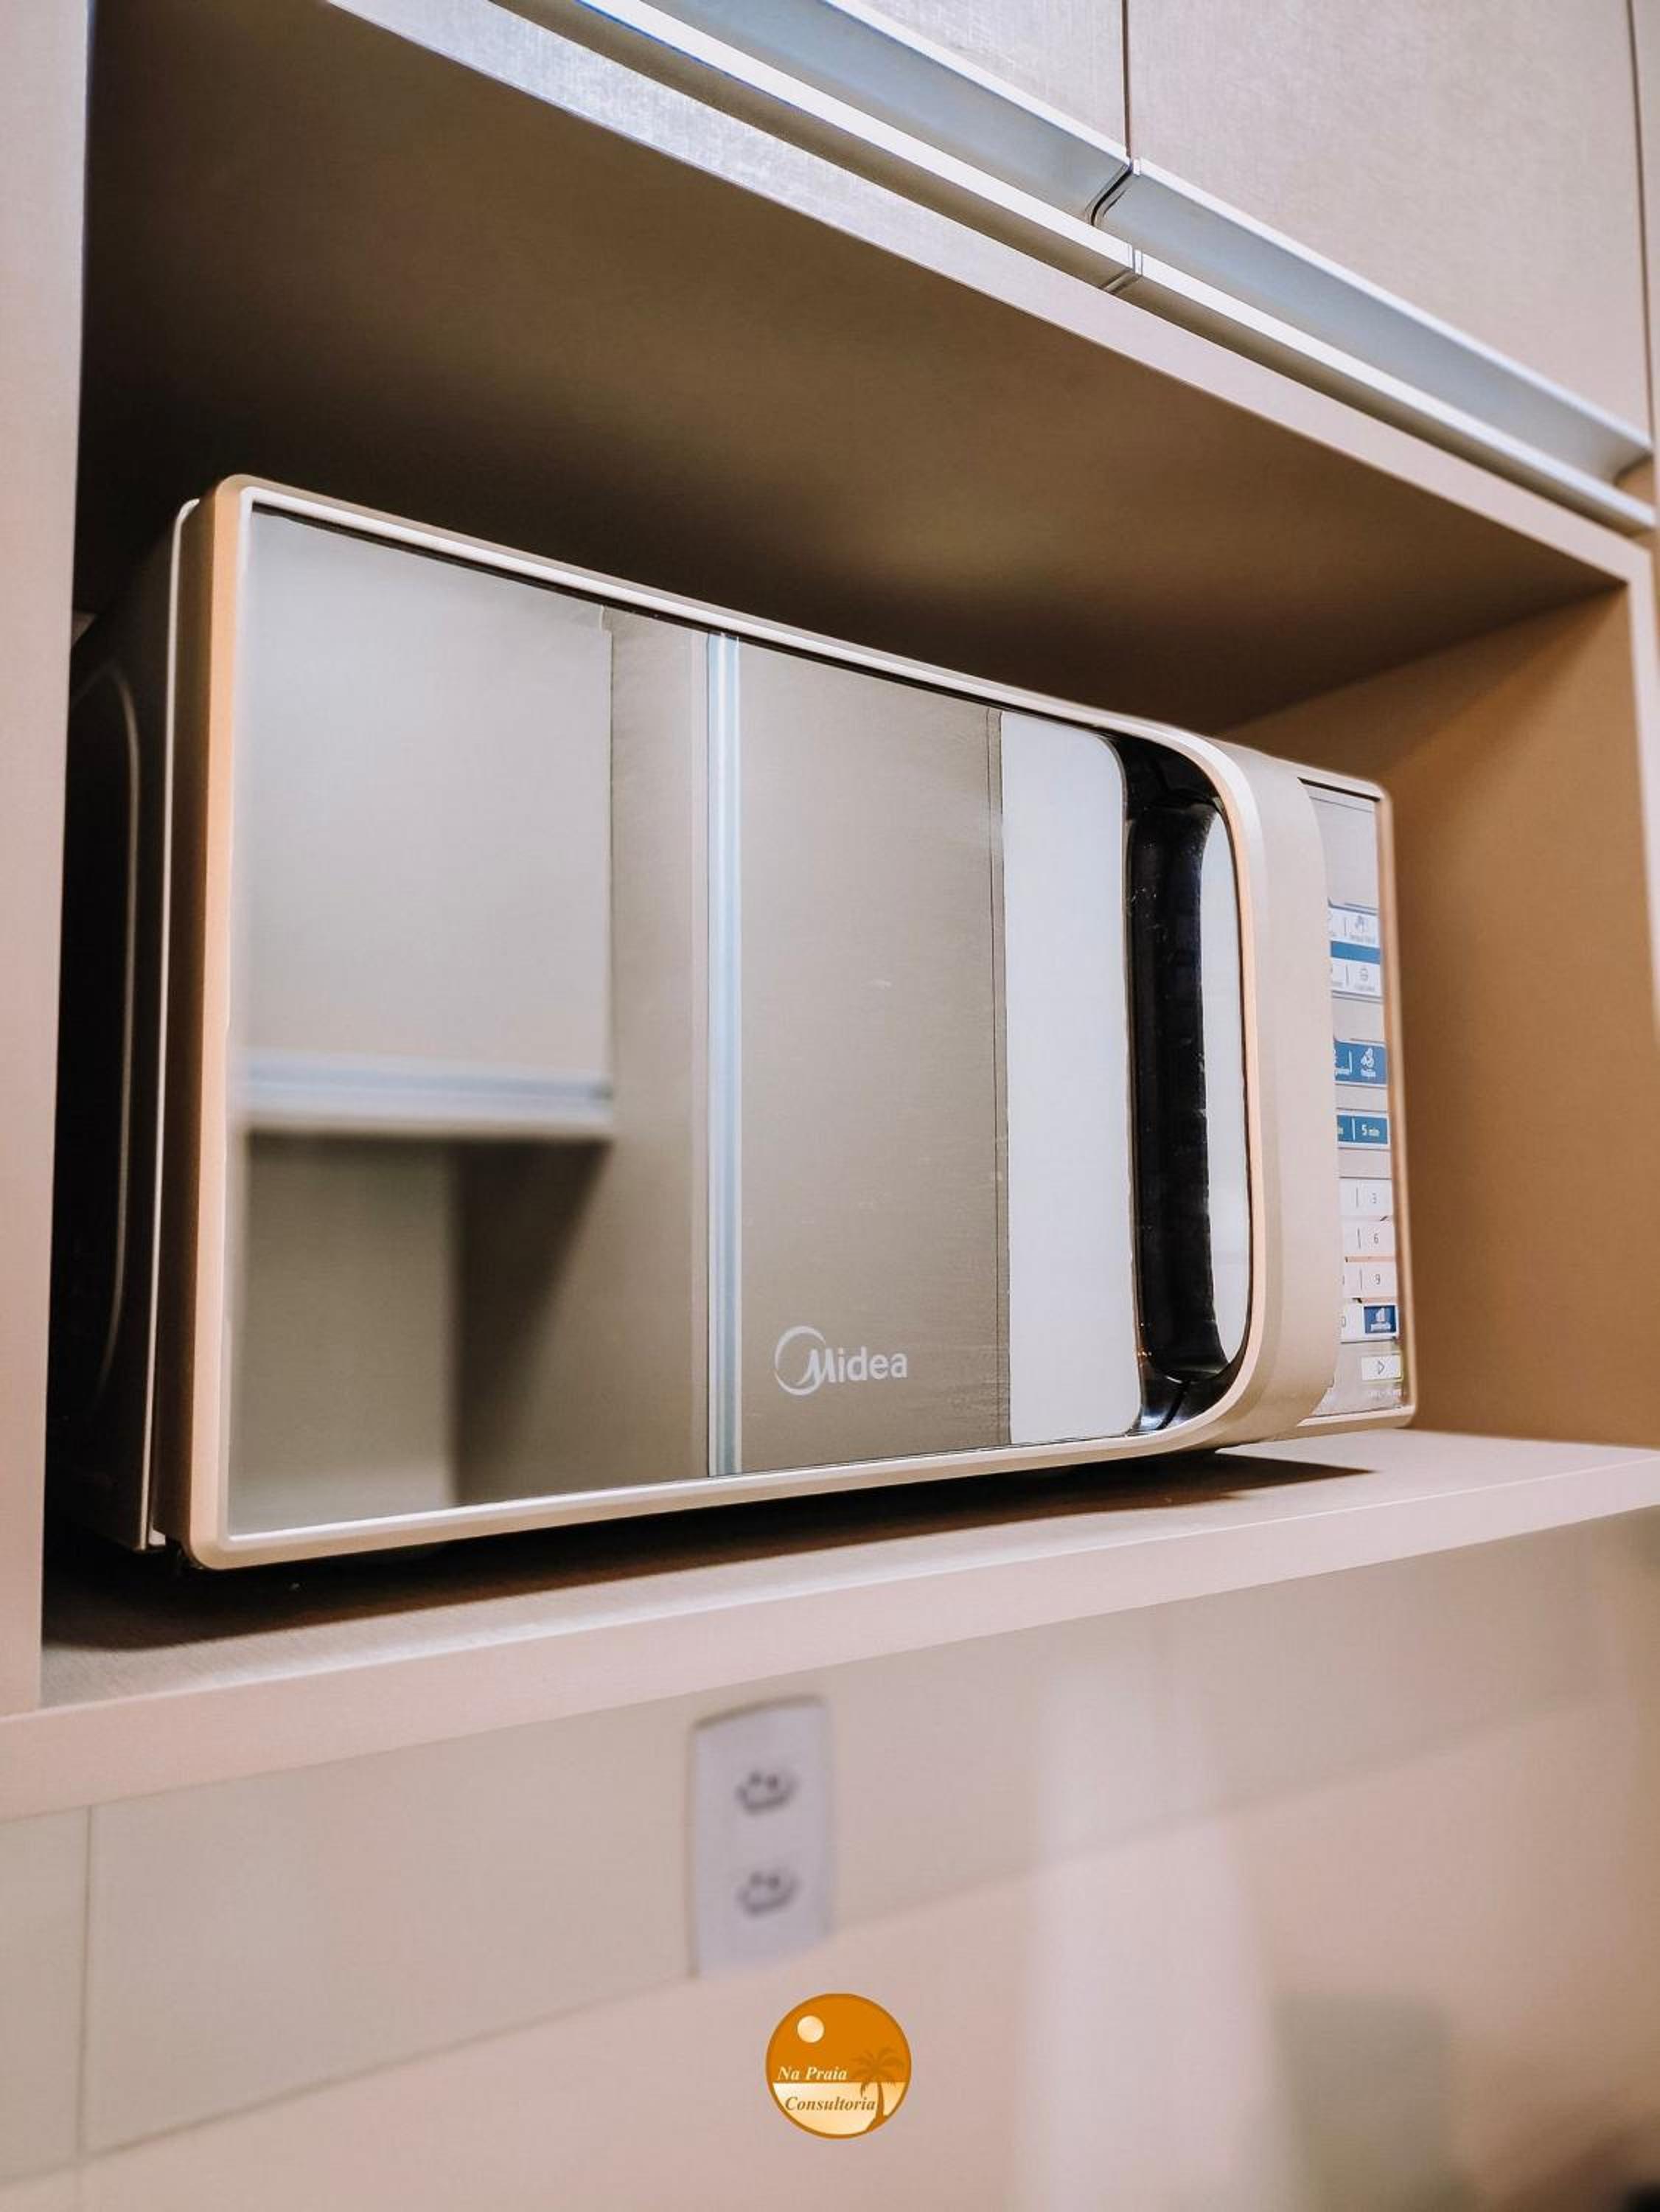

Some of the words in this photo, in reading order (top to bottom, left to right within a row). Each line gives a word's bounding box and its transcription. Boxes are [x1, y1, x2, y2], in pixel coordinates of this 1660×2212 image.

[1361, 1124, 1367, 1136] 5
[1370, 1192, 1377, 1204] 3
[1373, 1233, 1379, 1245] 6
[1375, 1273, 1381, 1285] 9
[774, 1326, 908, 1396] Midea
